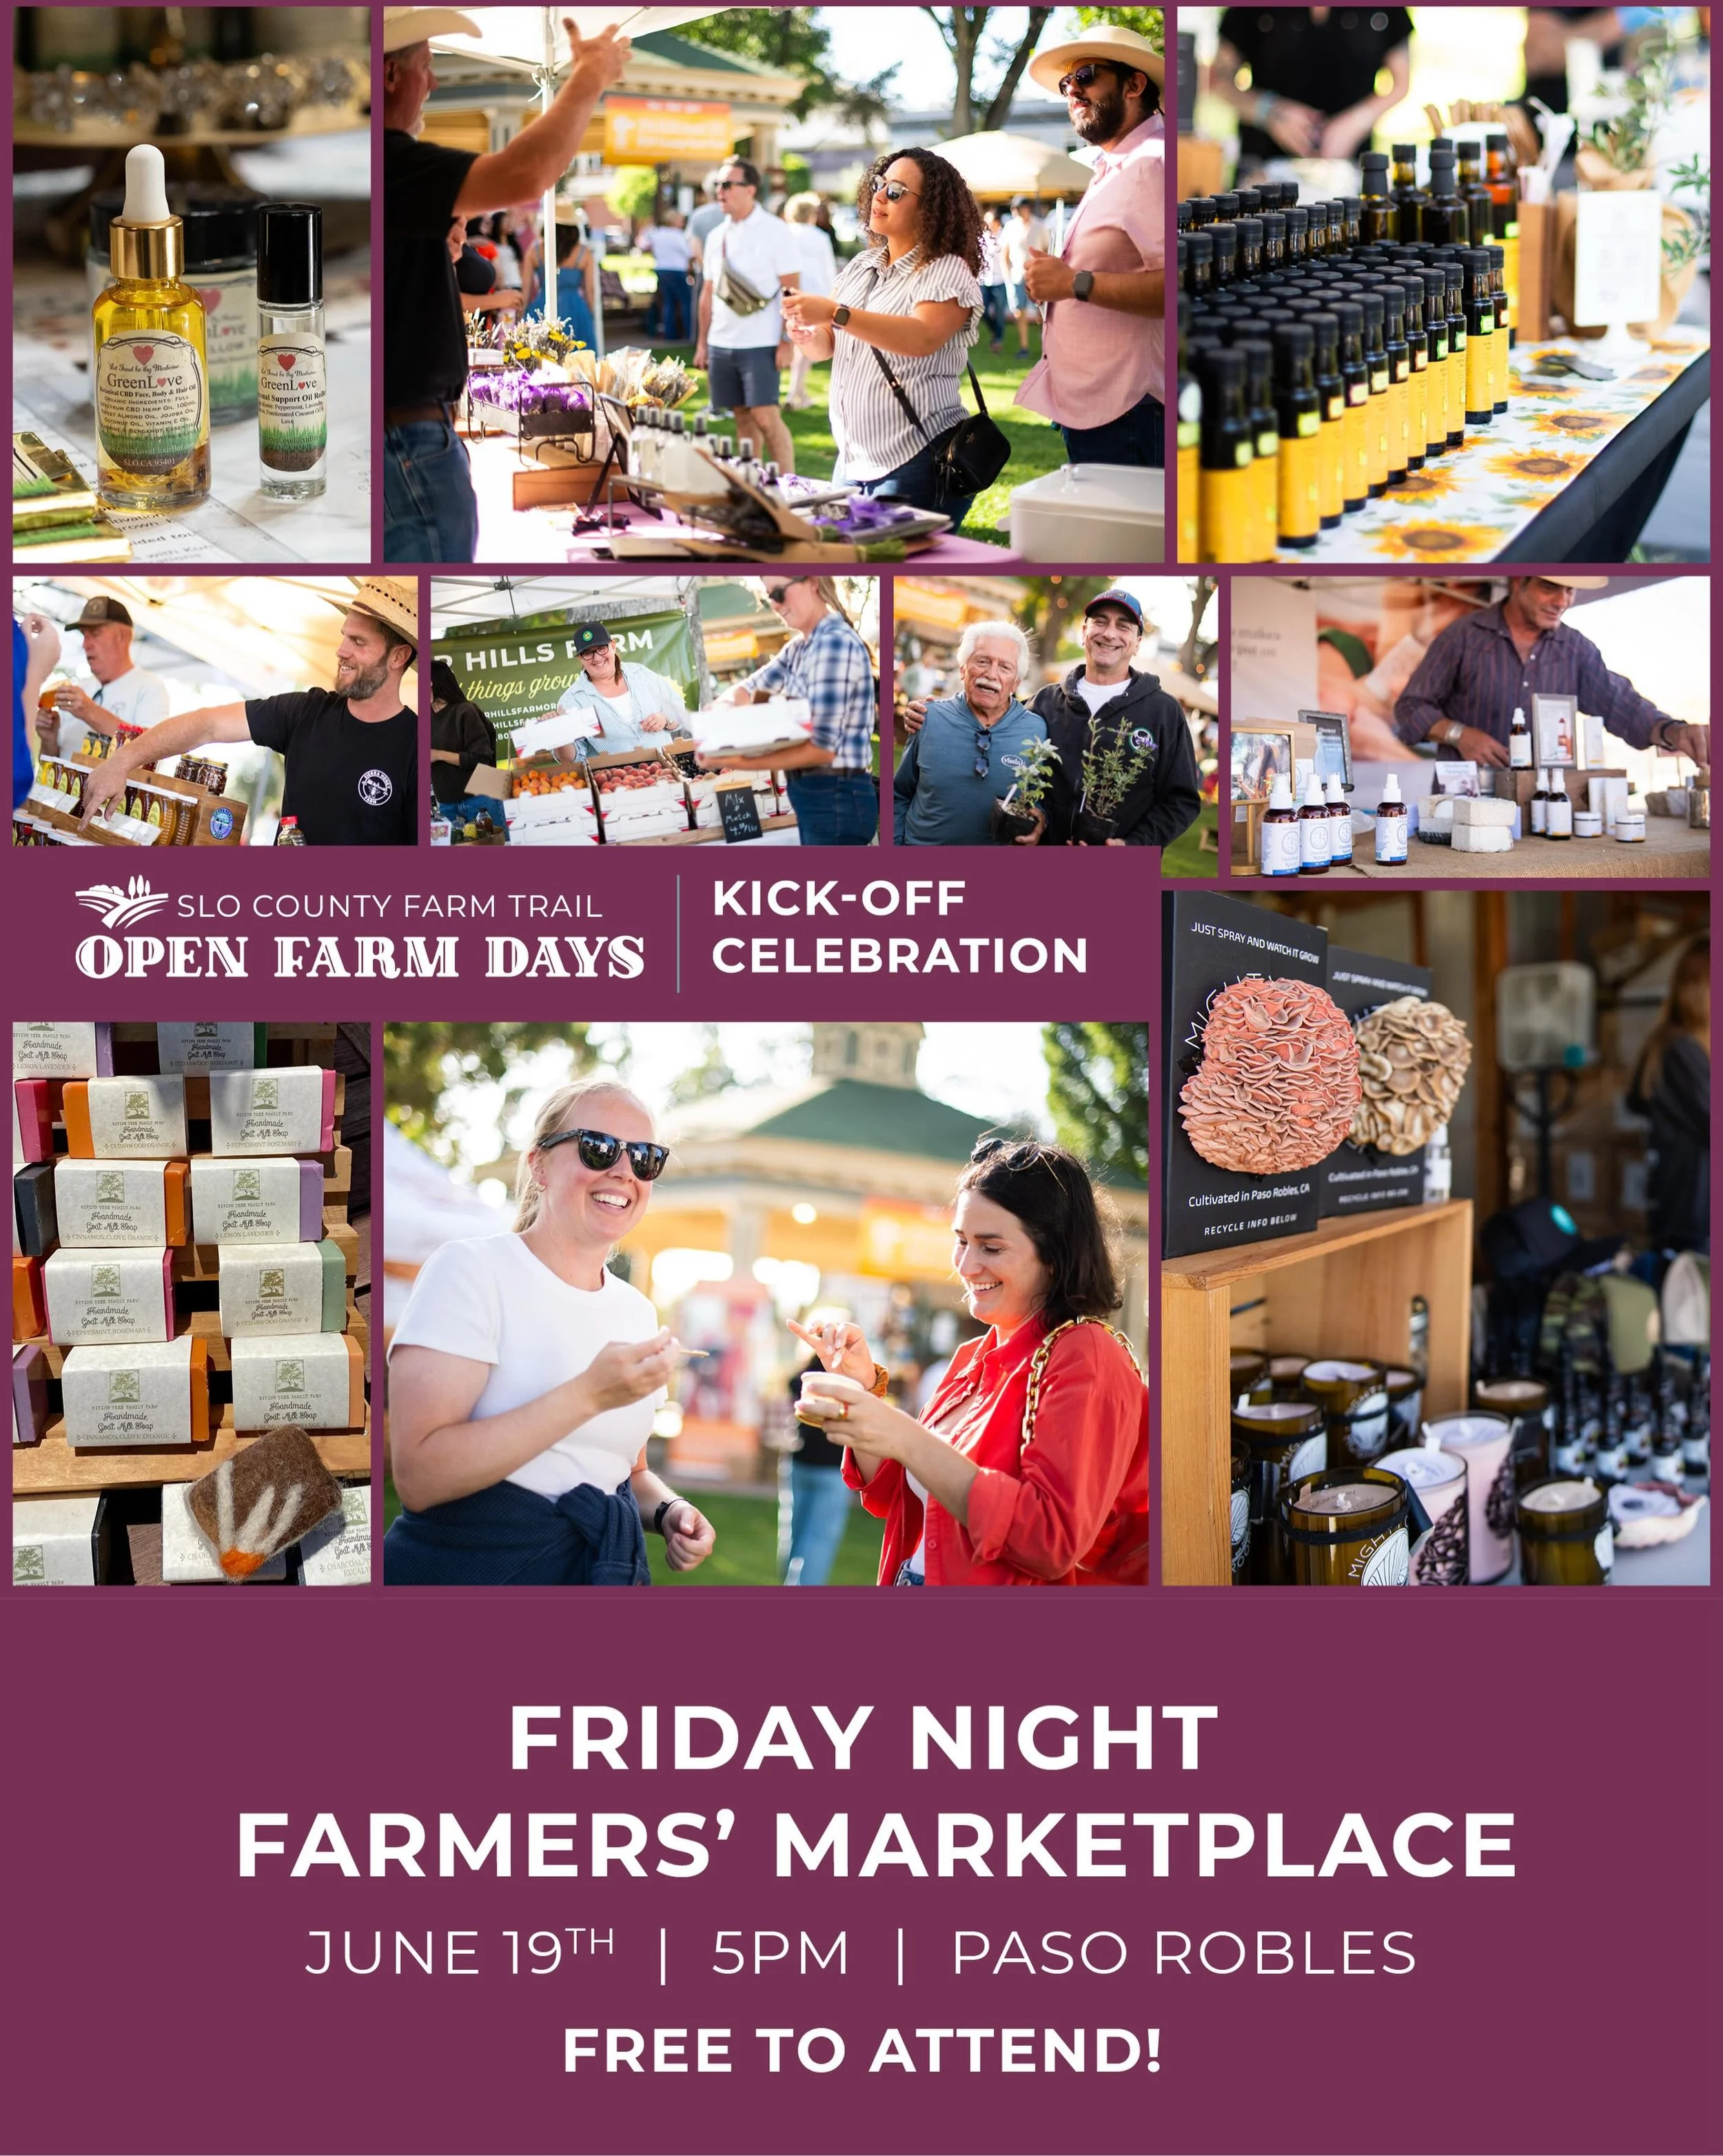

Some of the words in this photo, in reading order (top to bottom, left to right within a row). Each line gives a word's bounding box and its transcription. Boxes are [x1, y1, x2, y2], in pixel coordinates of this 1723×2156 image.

[271, 394, 300, 404] Support
[465, 642, 555, 672] HILLS
[467, 680, 526, 703] things
[1191, 922, 1216, 936] JUST
[1218, 928, 1246, 944] SPRAY
[1247, 935, 1265, 948] AND
[1266, 941, 1292, 956] WATCH
[1292, 948, 1299, 958] IT
[1299, 950, 1320, 964] GROW
[23, 1039, 63, 1050] Handmade
[245, 1119, 284, 1128] Handmade
[1188, 1191, 1239, 1207] Cultivated
[1241, 1190, 1250, 1201] in
[1251, 1188, 1272, 1201] Paso
[1273, 1186, 1299, 1197] Robles,
[1300, 1183, 1310, 1194] CA
[91, 1212, 132, 1221] Handmade
[227, 1210, 267, 1219] Handmade
[86, 1222, 102, 1233] Goat
[104, 1223, 119, 1232] Milk
[121, 1223, 137, 1232] Soap
[223, 1220, 238, 1232] Goat
[239, 1219, 254, 1230] Milk
[255, 1219, 272, 1228] Soap
[1204, 1221, 1245, 1236] RECYCLE
[1247, 1218, 1268, 1229] INFO
[1270, 1213, 1298, 1225] BELOW
[86, 1305, 130, 1316] Handmade
[81, 1317, 98, 1328] Goat
[100, 1316, 116, 1327] Milk
[117, 1316, 135, 1325] Soap
[269, 1401, 312, 1411] Handmade
[103, 1412, 148, 1421] Handmade
[264, 1413, 281, 1423] Goat
[282, 1412, 298, 1421] Milk
[299, 1412, 317, 1420] Soap
[98, 1423, 115, 1434] Goat
[117, 1421, 134, 1432] Milk
[135, 1421, 153, 1432] Soap
[1348, 1525, 1400, 1577] MIGH
